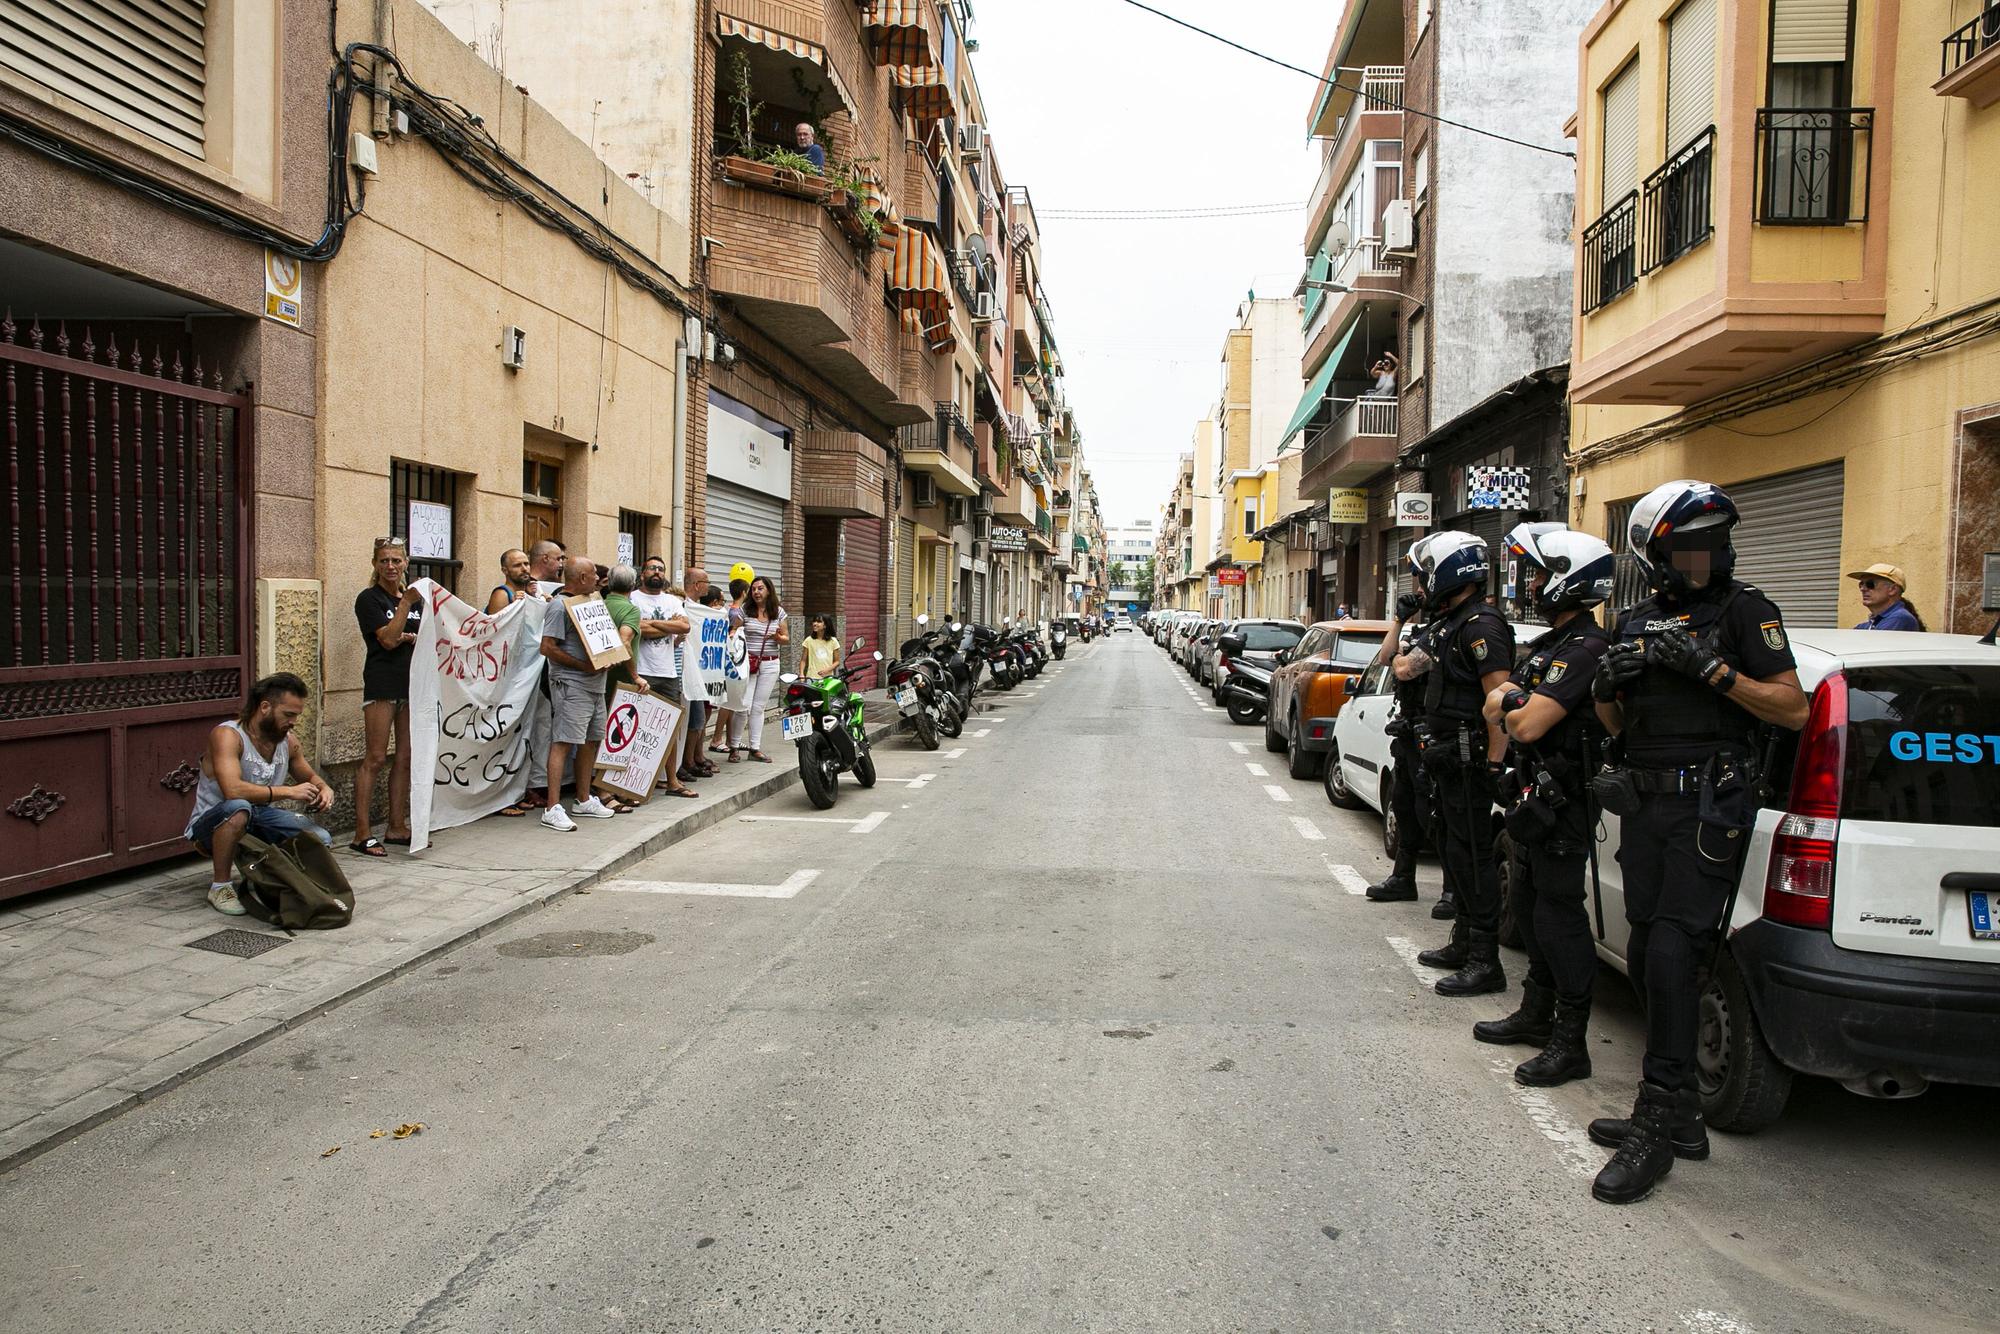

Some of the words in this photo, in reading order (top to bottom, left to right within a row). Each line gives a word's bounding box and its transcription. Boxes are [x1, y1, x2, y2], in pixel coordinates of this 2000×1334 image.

[1489, 475, 1526, 488] MOTO
[992, 528, 1023, 538] AUTO-GAS
[430, 536, 445, 556] YA
[1552, 580, 1567, 602] CNP
[1645, 621, 1689, 631] NACIONAL
[622, 692, 642, 704] STOP
[790, 714, 809, 725] 1767
[789, 724, 805, 735] LGX
[1860, 912, 1922, 926] Panda
[1978, 915, 1987, 924] E
